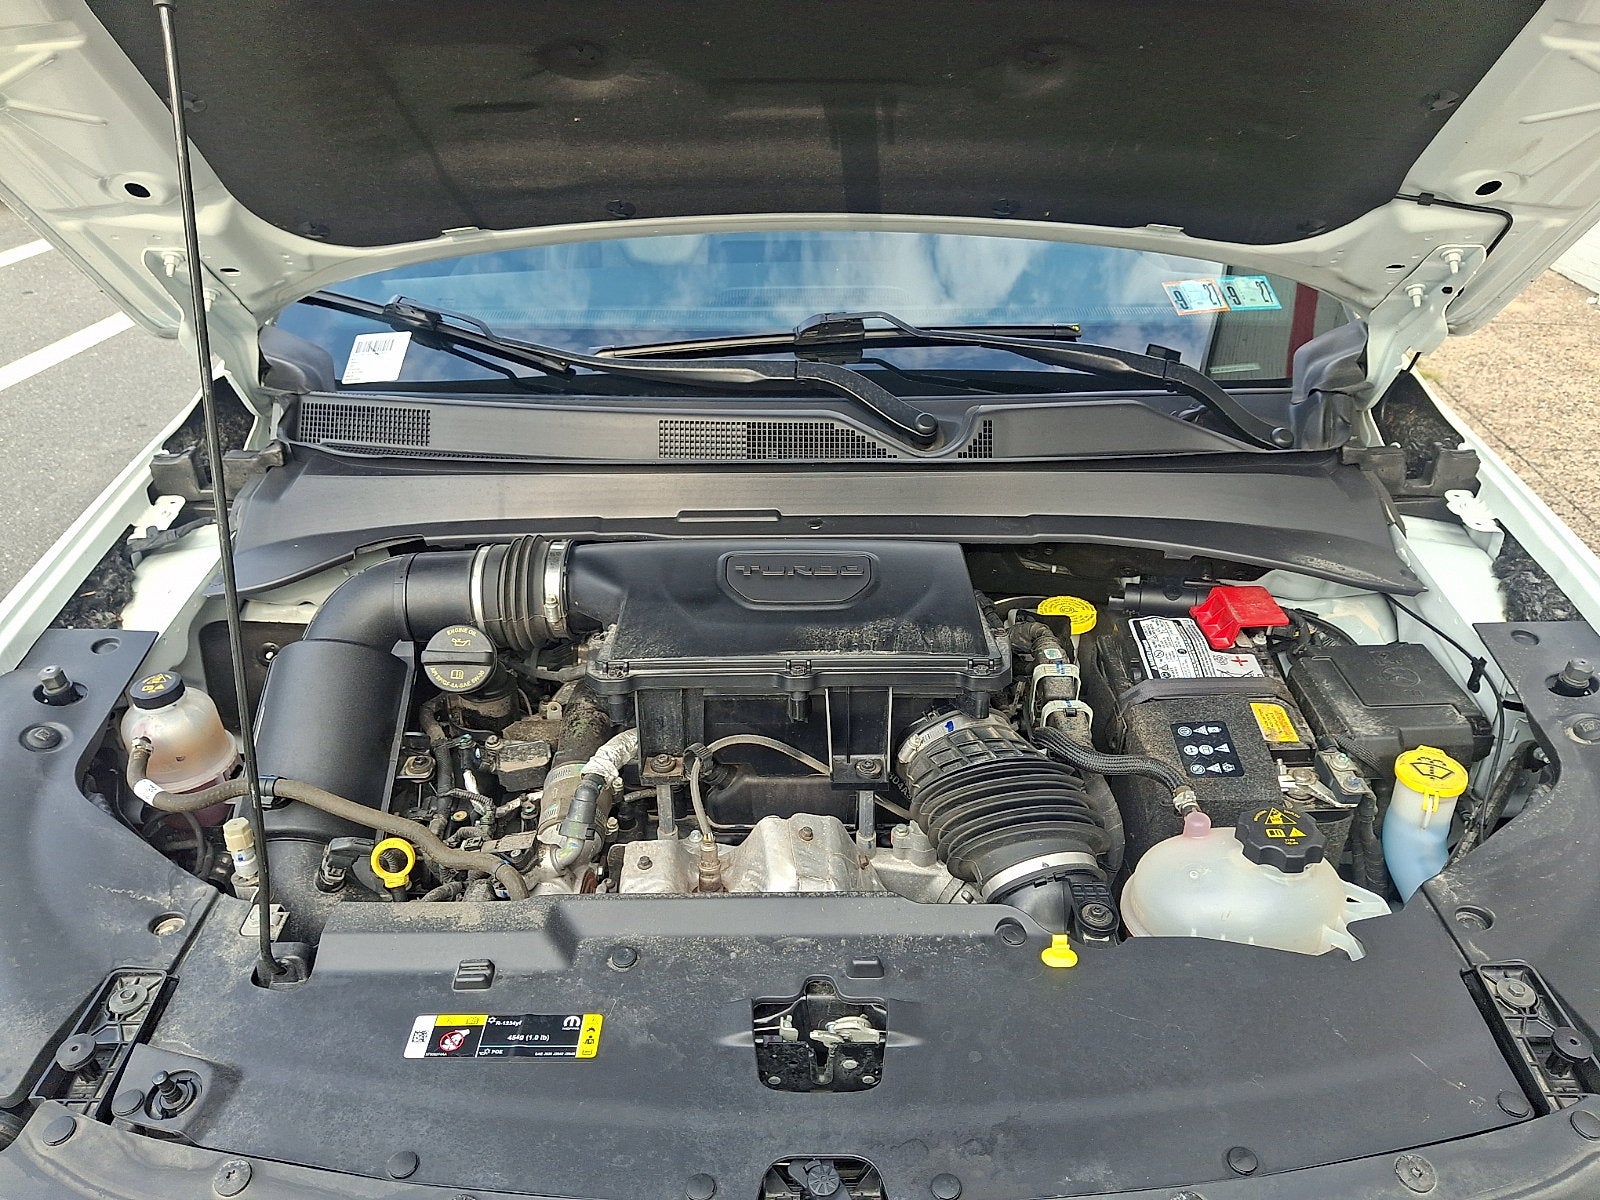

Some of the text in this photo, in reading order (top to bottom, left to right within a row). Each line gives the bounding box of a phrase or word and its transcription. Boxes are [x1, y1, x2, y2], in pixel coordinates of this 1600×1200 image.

[1173, 290, 1189, 310] 9
[1227, 286, 1242, 306] 9
[735, 565, 864, 576] TURBO
[446, 627, 477, 637] ENGINE OIL
